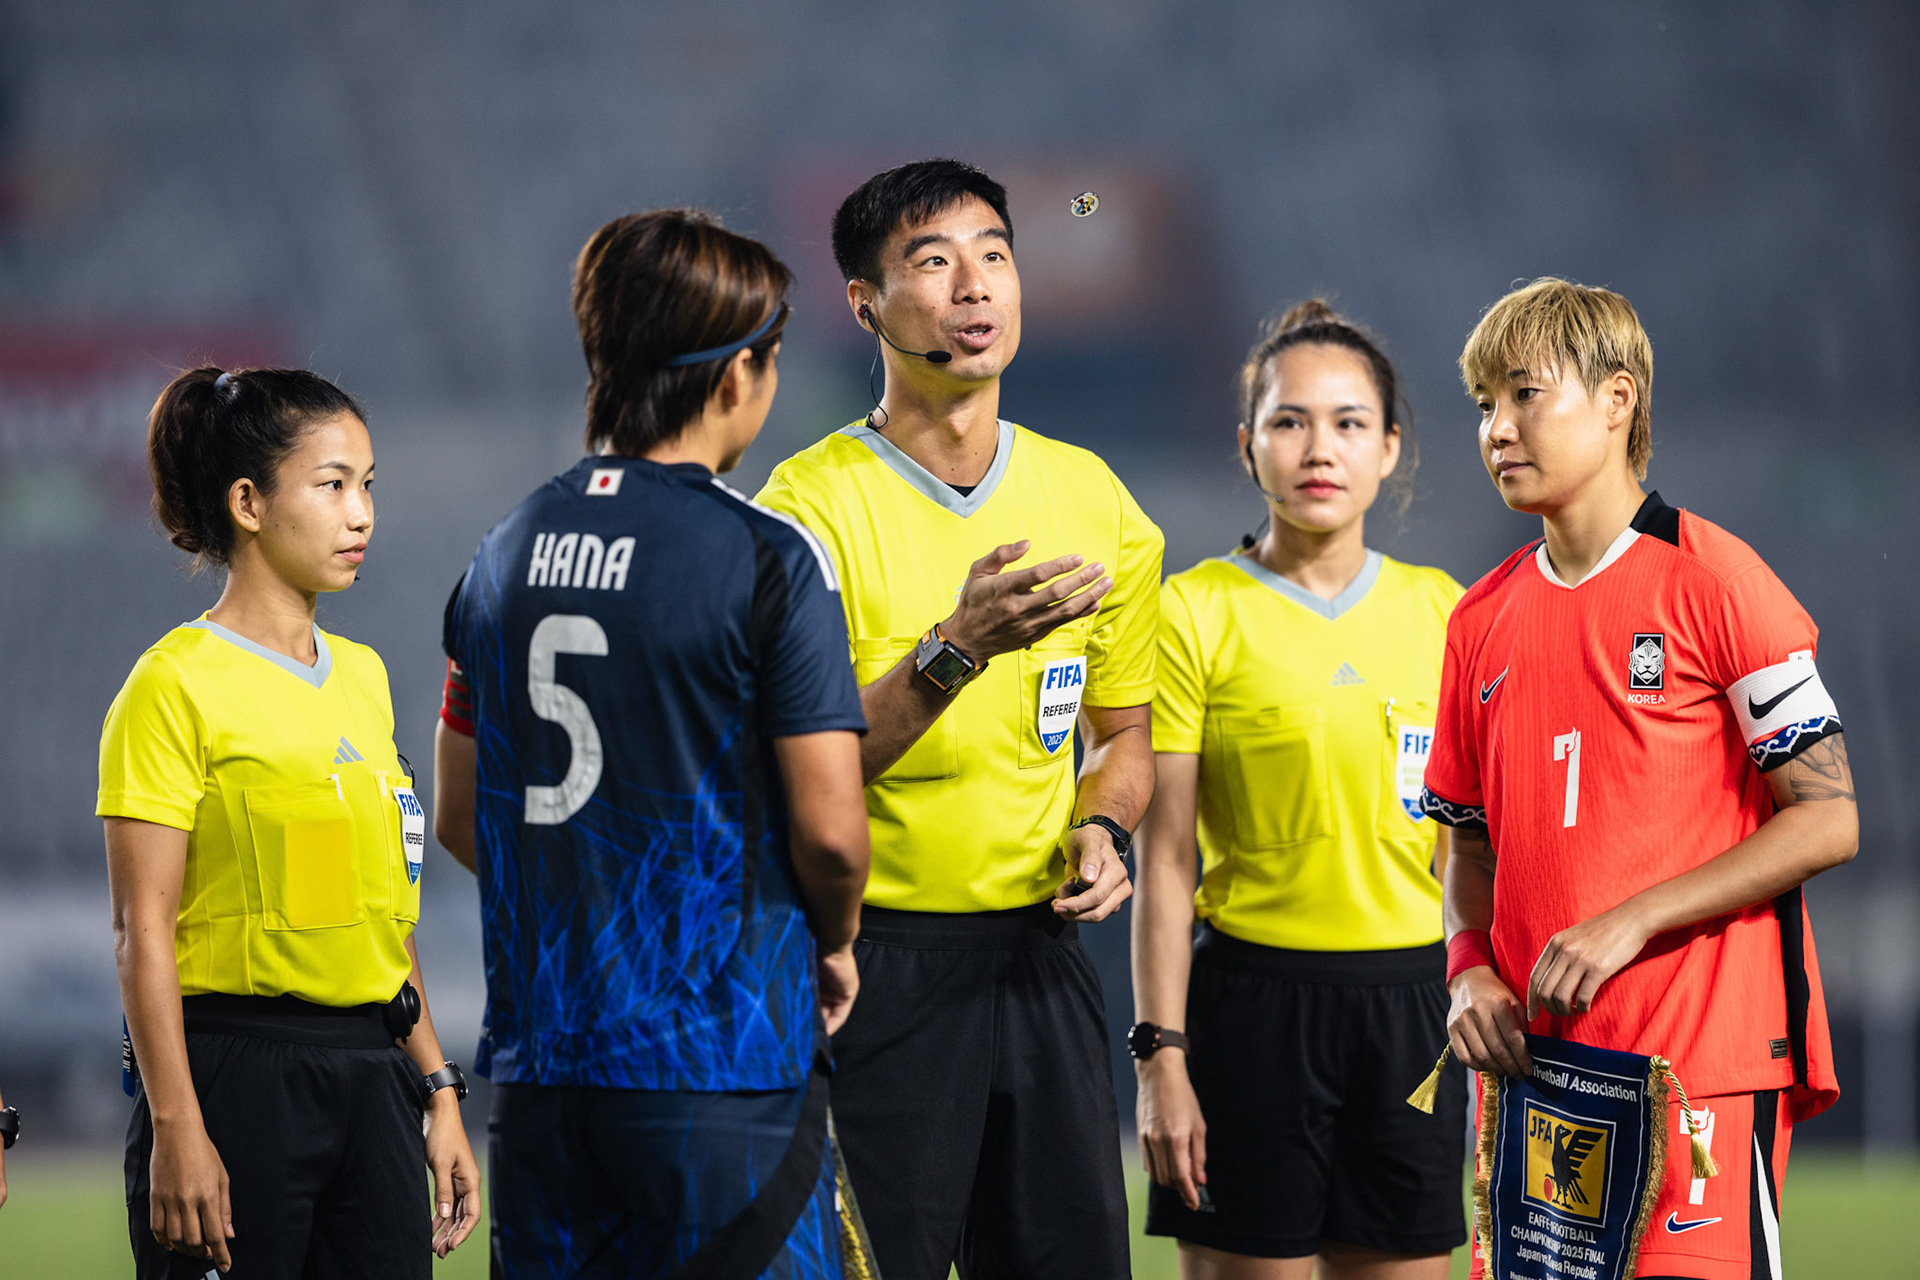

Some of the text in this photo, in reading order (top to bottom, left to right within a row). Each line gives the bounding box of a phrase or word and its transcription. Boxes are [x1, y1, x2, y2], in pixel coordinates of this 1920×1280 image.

[527, 532, 636, 591] HANA
[1046, 664, 1082, 690] FIFA
[1043, 701, 1078, 718] REFEREE
[1627, 693, 1666, 704] KOREA
[524, 613, 609, 825] 5
[1047, 733, 1063, 746] 2025
[1404, 733, 1431, 755] FIF
[398, 794, 423, 817] FIFA
[1569, 1075, 1638, 1102] Association
[1529, 1115, 1553, 1144] JFA
[1517, 1244, 1541, 1262] Japan
[1563, 1260, 1598, 1280] Republic
[1561, 1243, 1584, 1260] 2025
[1584, 1248, 1606, 1265] FINAL
